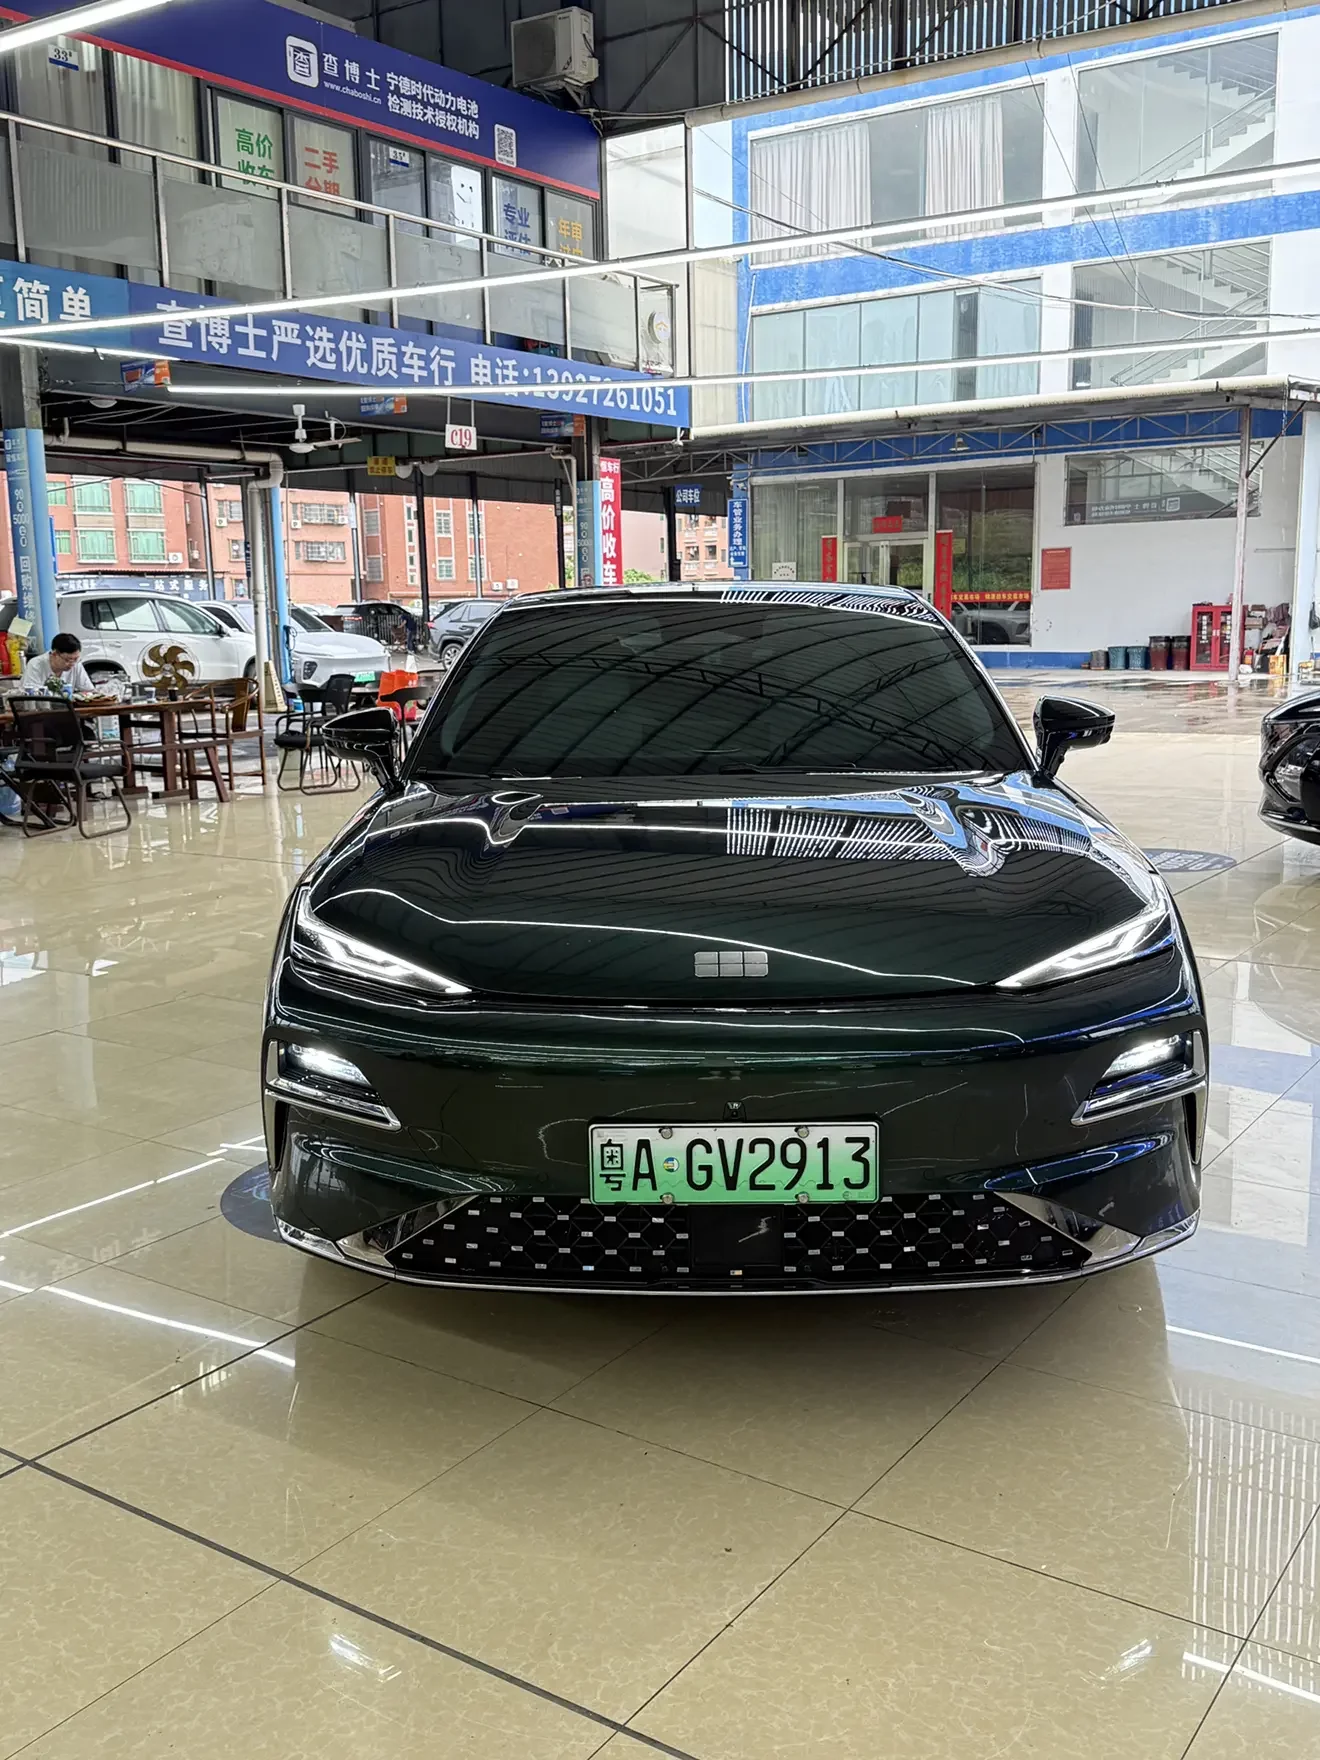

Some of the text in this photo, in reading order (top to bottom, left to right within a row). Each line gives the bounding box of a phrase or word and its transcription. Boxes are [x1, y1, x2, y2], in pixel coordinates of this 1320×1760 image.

[322, 53, 380, 91] 查博士
[323, 81, 382, 105] www.chaboshi.cn
[386, 72, 479, 118] 宁德时代动力电池
[387, 93, 480, 139] 检测技术授权机构
[235, 128, 273, 159] 高价
[304, 146, 339, 174] 二手
[503, 203, 530, 228] 专业
[0, 276, 92, 323] 简单
[156, 300, 455, 386] 查博士严选优质车行
[676, 488, 700, 503] 公司车位
[600, 476, 618, 586] 高价收车
[139, 579, 209, 591] 一站式服务
[686, 1137, 871, 1191] GV2913
